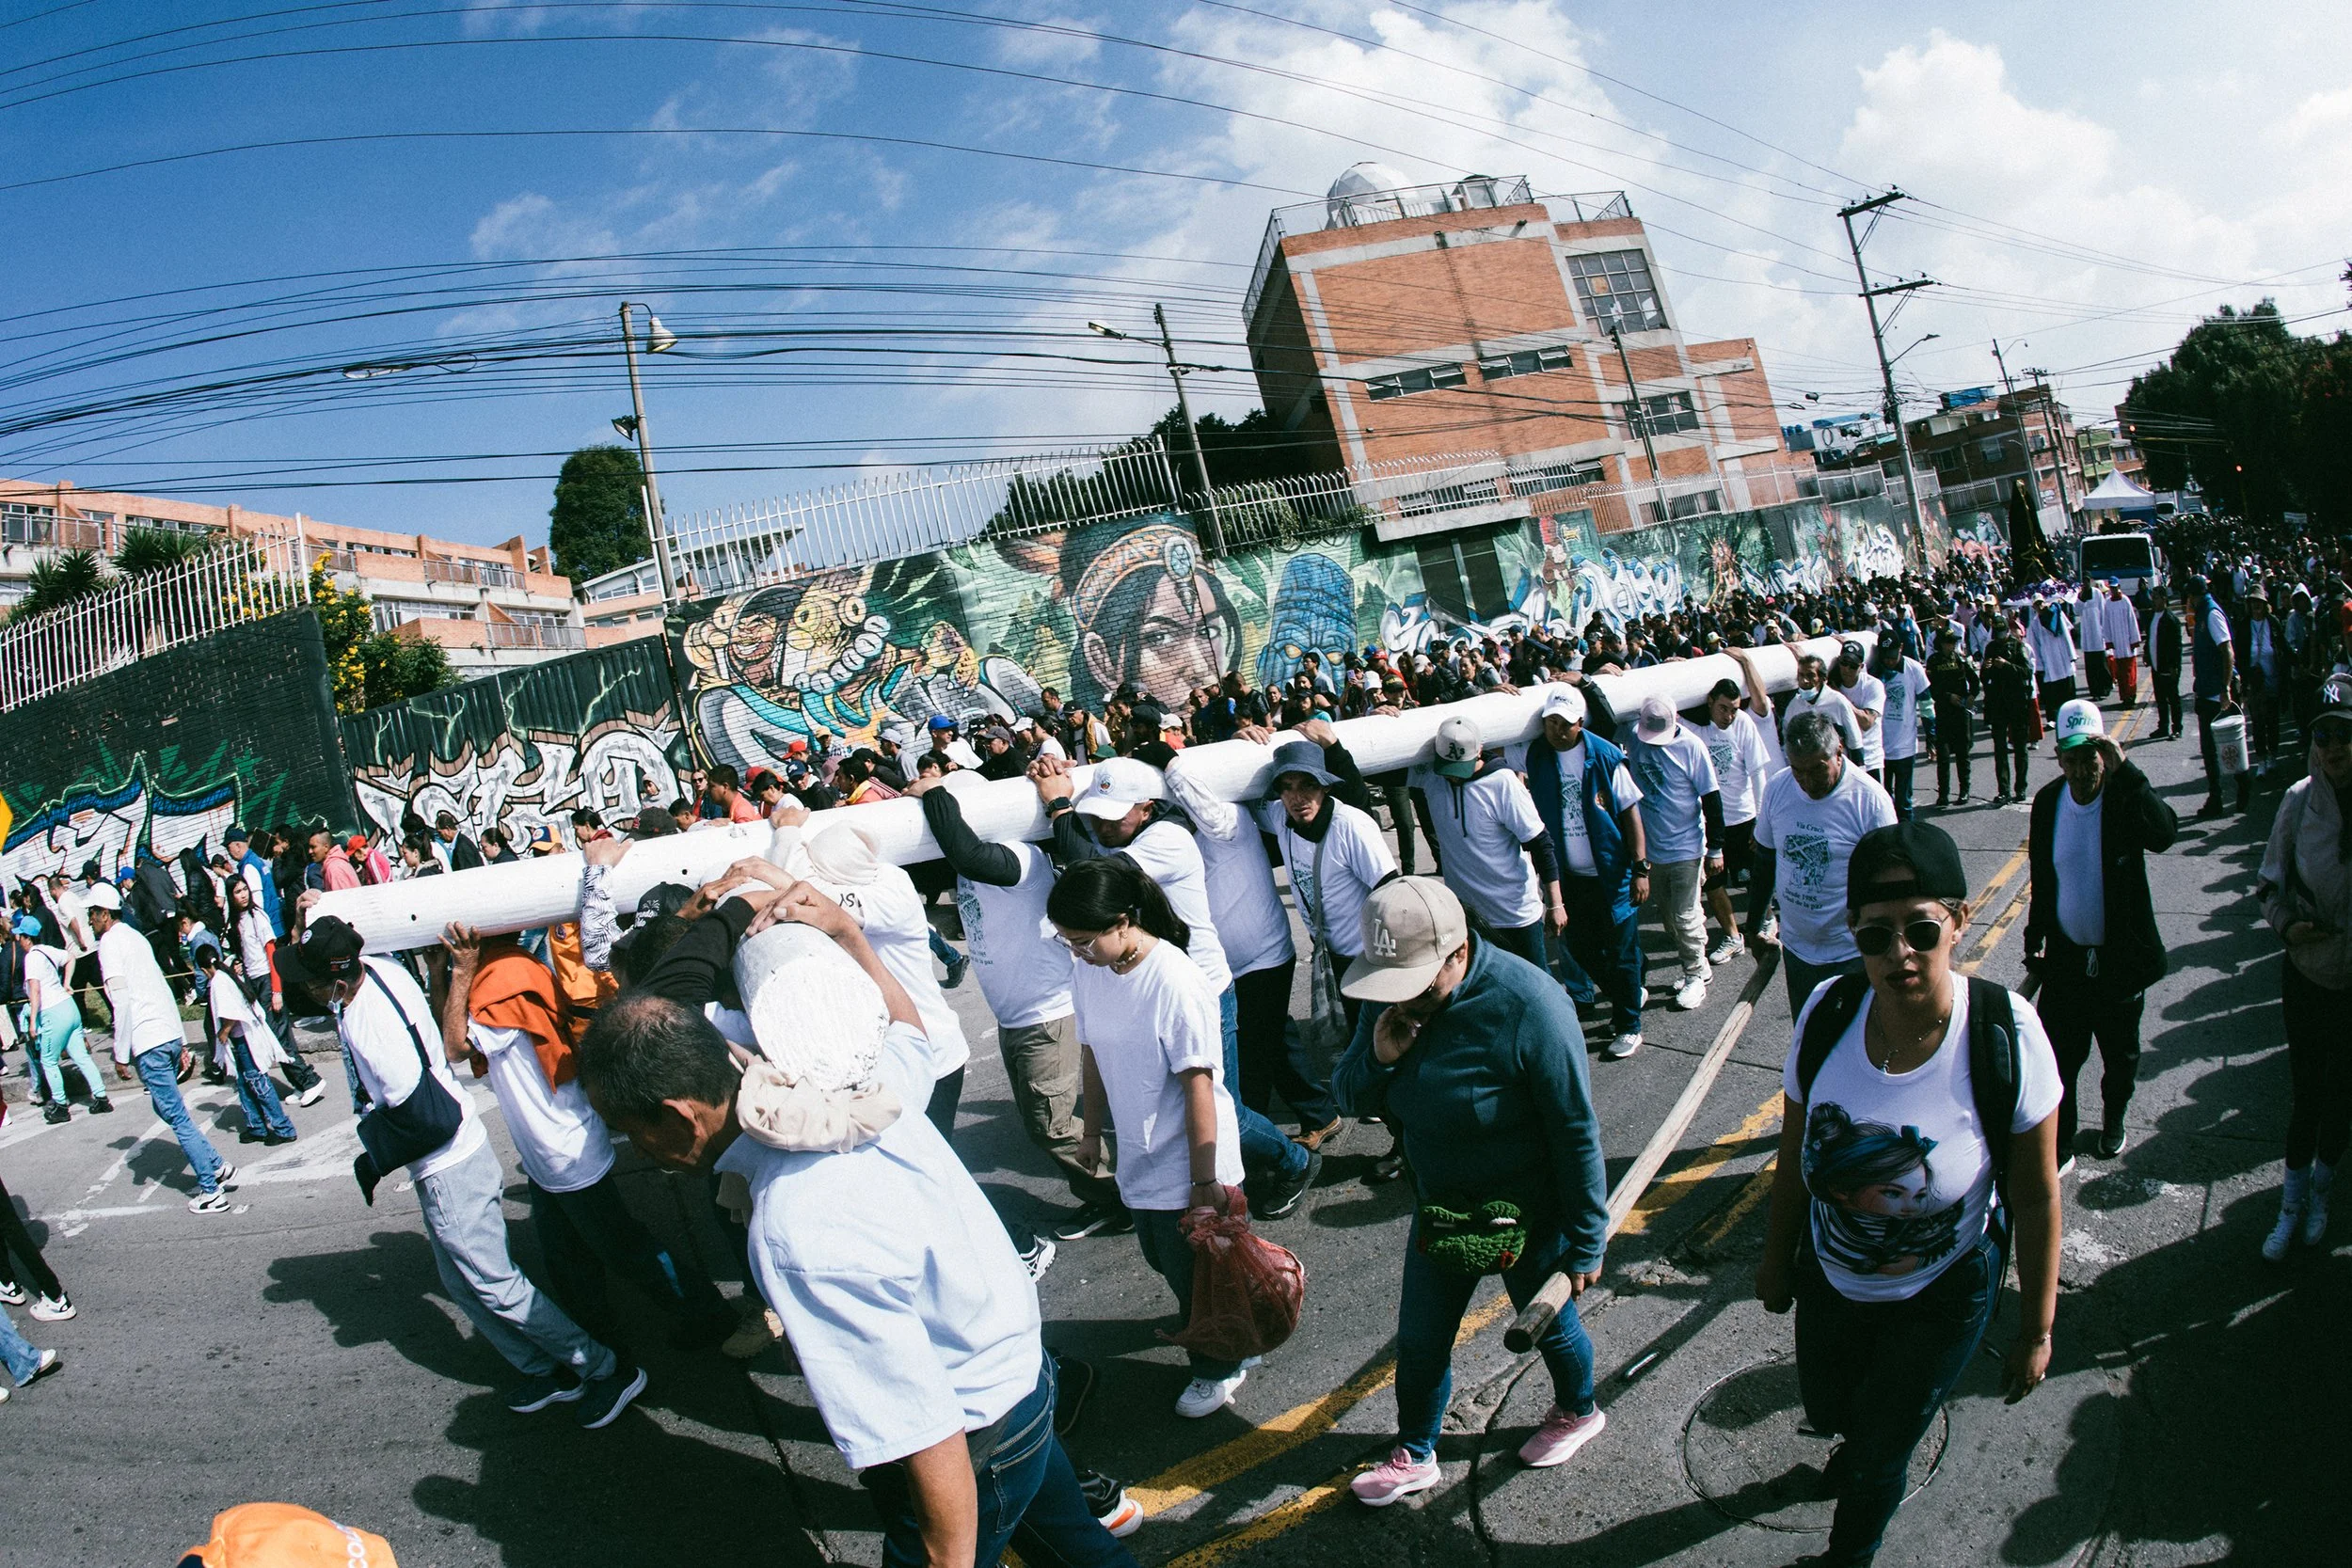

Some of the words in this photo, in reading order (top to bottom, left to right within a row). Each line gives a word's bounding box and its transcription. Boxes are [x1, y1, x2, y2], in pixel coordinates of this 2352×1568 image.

[2323, 683, 2341, 704] NY
[2066, 715, 2097, 729] Sprite
[1374, 918, 1397, 958] LA
